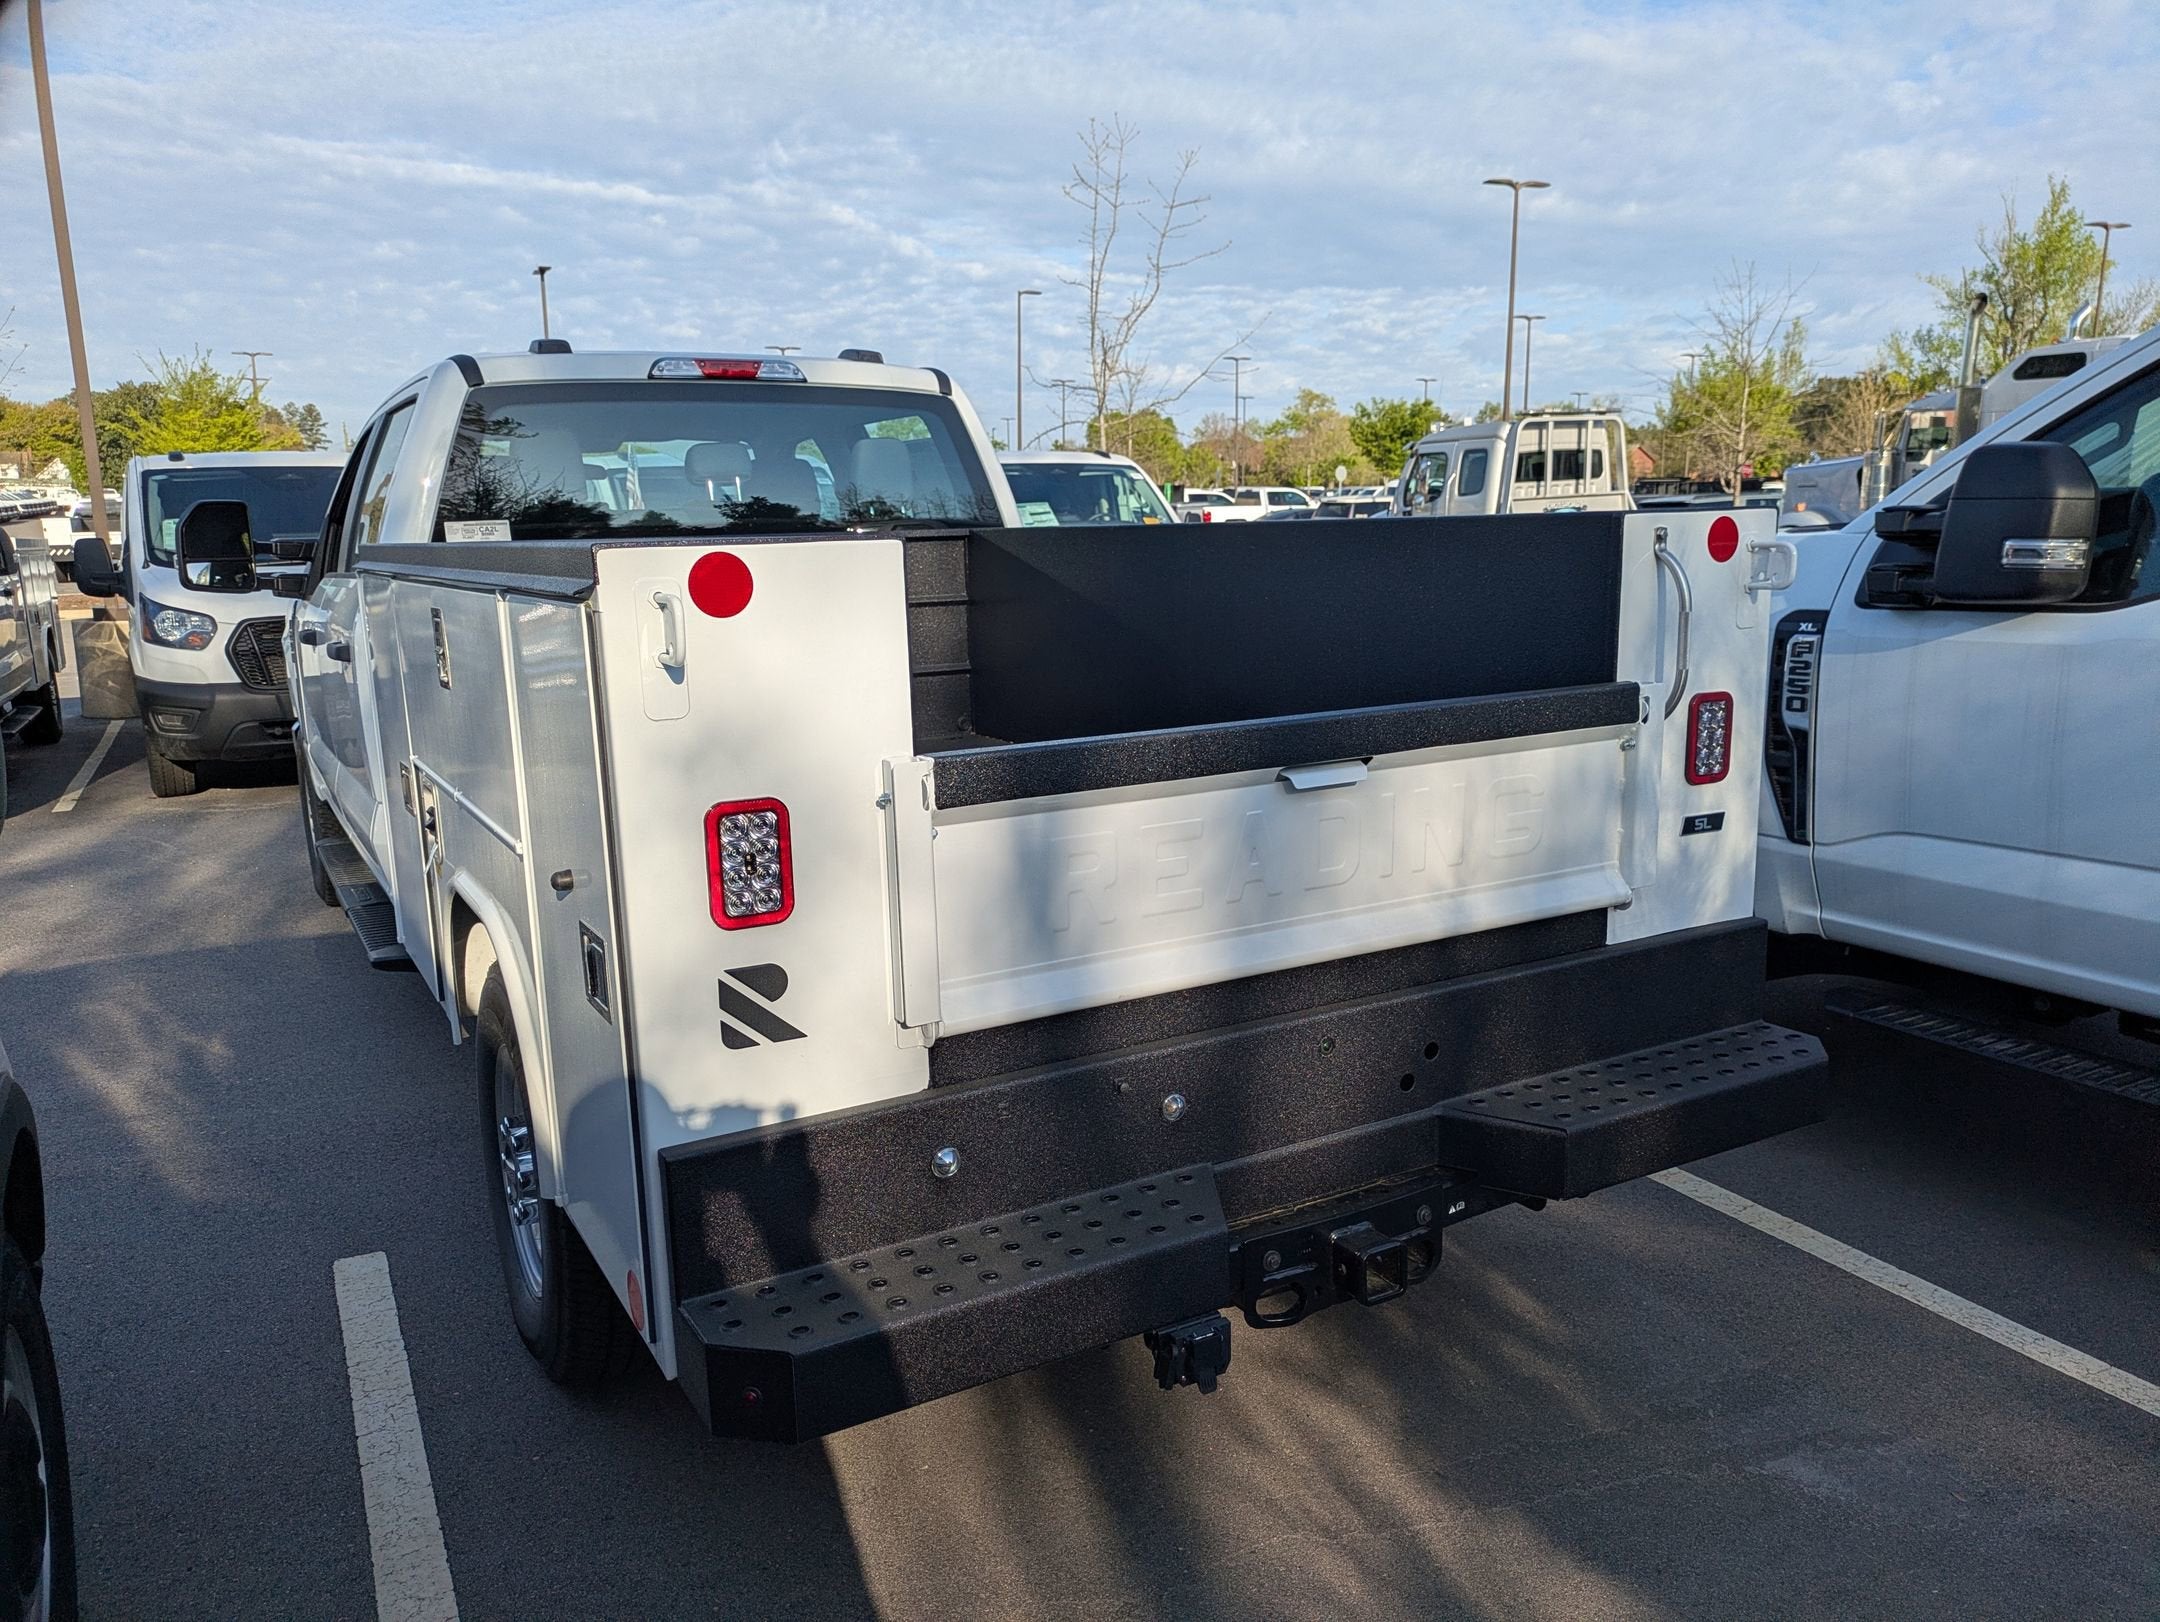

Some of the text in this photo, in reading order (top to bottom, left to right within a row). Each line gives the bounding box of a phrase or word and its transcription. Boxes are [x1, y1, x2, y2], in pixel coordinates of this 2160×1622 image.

[1798, 622, 1817, 632] XL
[1786, 640, 1814, 713] F250
[1050, 776, 1545, 932] READING
